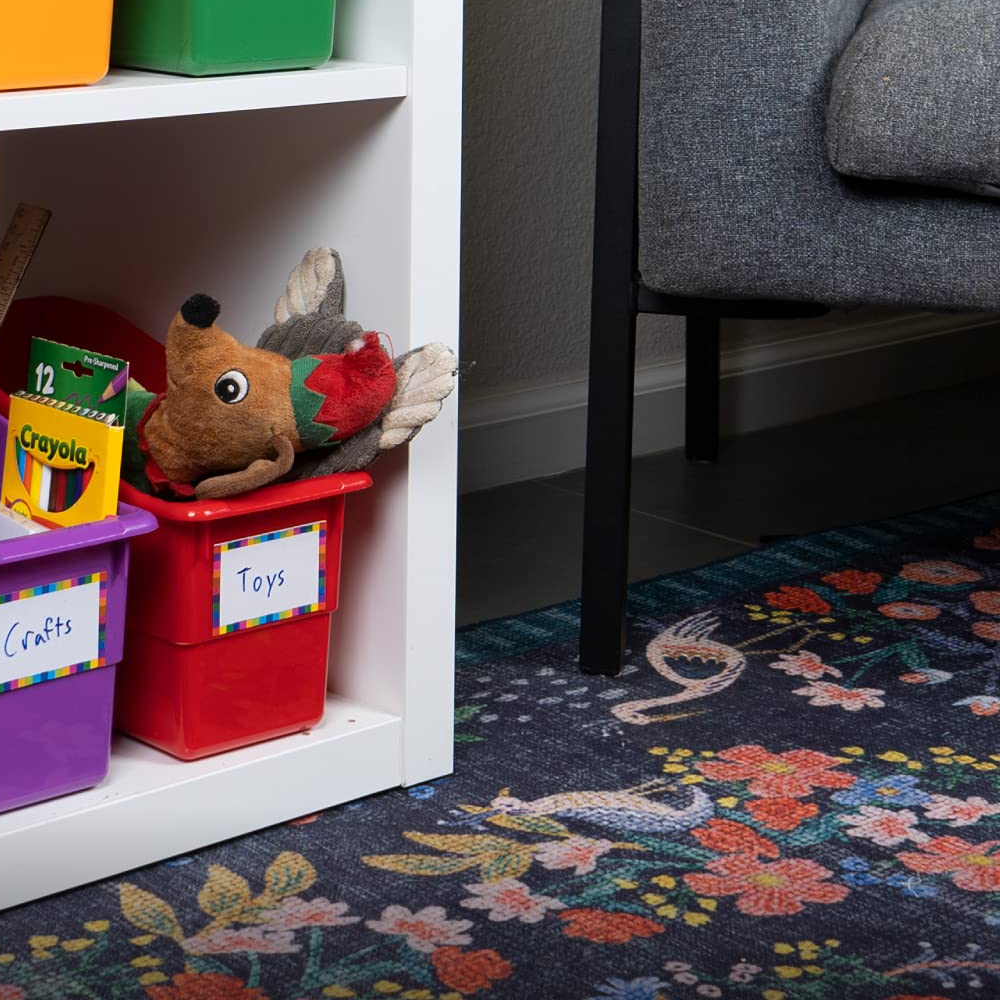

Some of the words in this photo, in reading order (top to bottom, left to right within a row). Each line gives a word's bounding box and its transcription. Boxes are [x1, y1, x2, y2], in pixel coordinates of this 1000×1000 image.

[35, 361, 55, 395] 12
[83, 354, 119, 372] Pre-Sharpened
[19, 424, 88, 465] Crayola
[237, 566, 286, 598] Toys
[3, 616, 73, 658] Crafts
